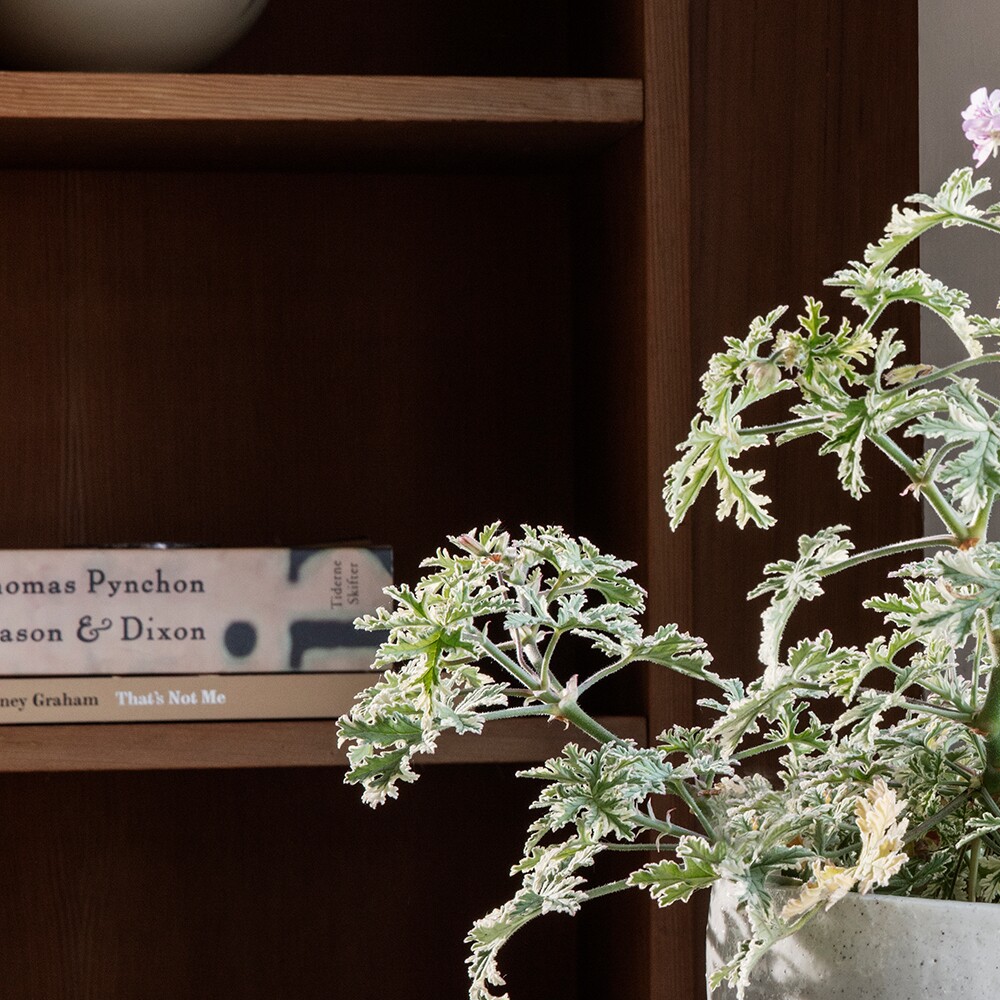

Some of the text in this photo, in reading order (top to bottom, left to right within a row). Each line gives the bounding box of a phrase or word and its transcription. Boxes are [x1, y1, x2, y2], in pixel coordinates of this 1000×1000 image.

[87, 568, 205, 597] Pynchon
[331, 560, 342, 609] Tiderne
[346, 562, 359, 605] Skifter
[77, 615, 113, 643] &
[121, 616, 207, 641] Dixon
[33, 692, 99, 706] Graham
[168, 689, 198, 705] Not
[202, 689, 227, 704] Me
